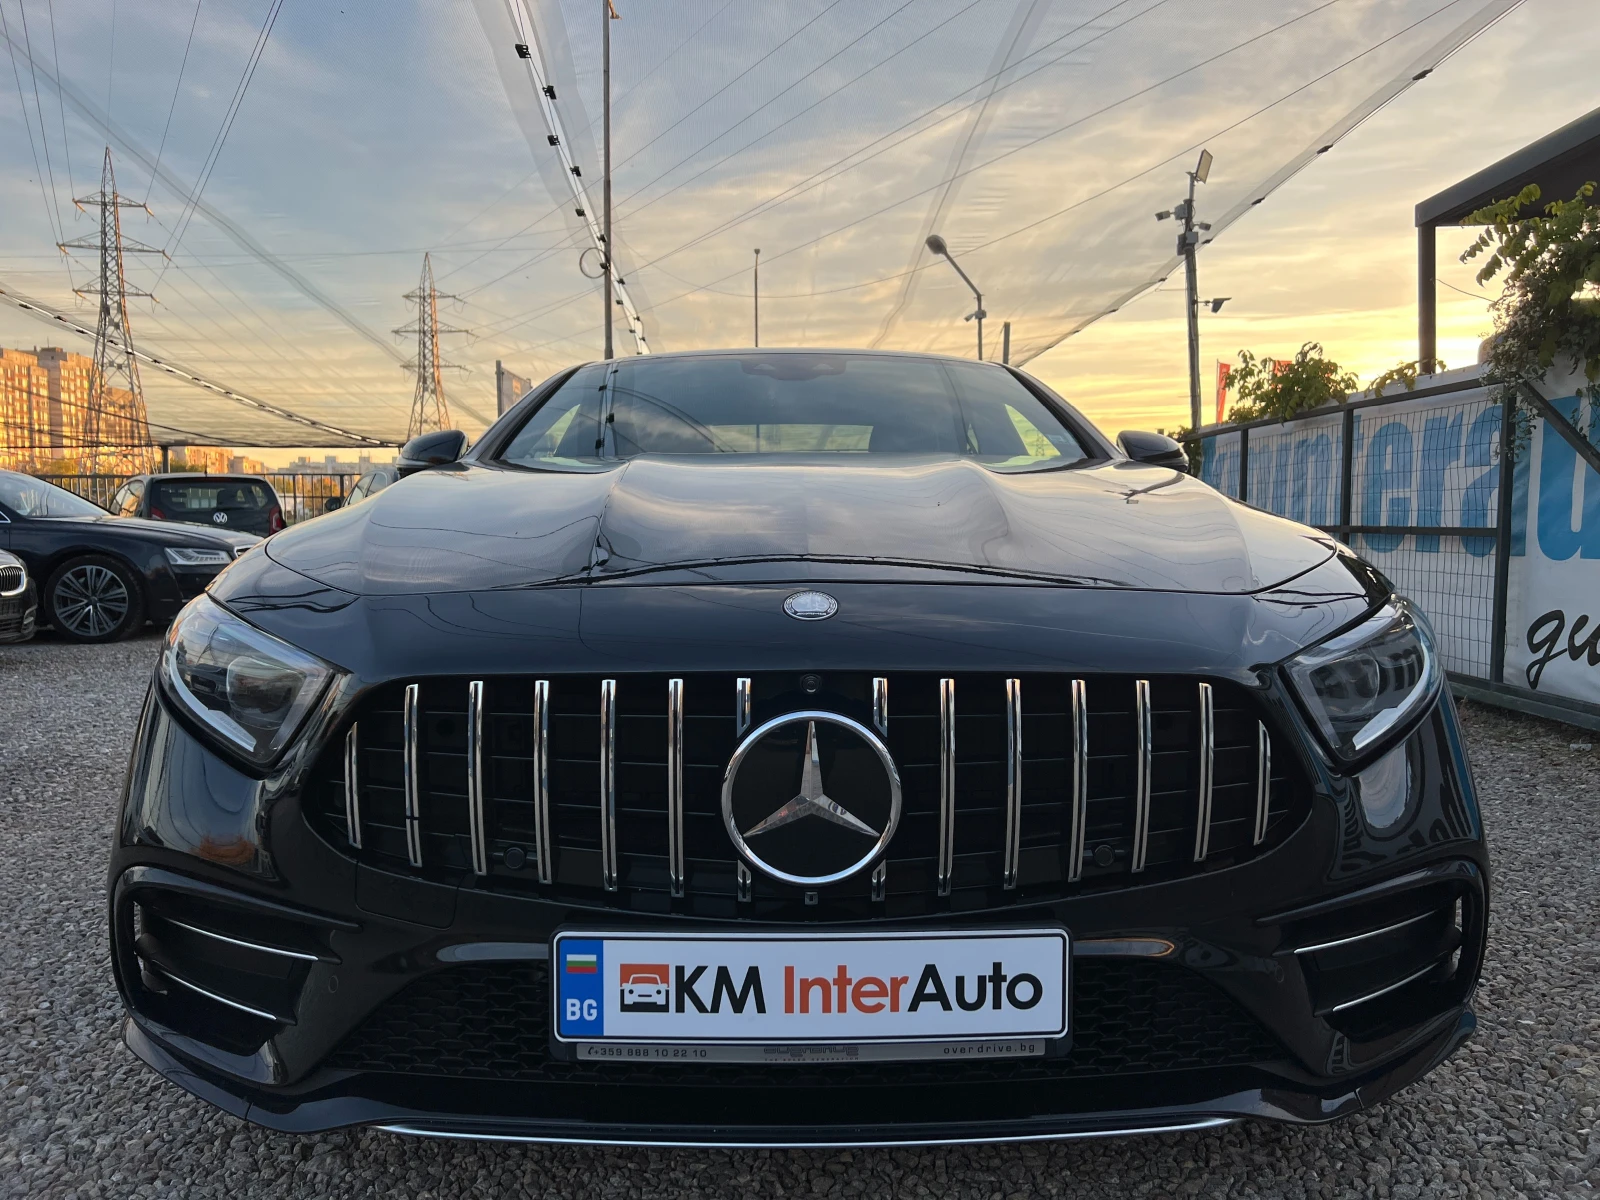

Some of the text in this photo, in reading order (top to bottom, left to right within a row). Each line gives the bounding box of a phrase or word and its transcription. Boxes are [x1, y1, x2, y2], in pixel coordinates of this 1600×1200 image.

[674, 961, 1043, 1014] KM InterAuto
[566, 998, 598, 1021] BG
[626, 1047, 649, 1057] 888
[654, 1048, 669, 1058] 10
[673, 1048, 688, 1058] 22
[692, 1049, 707, 1058] 10
